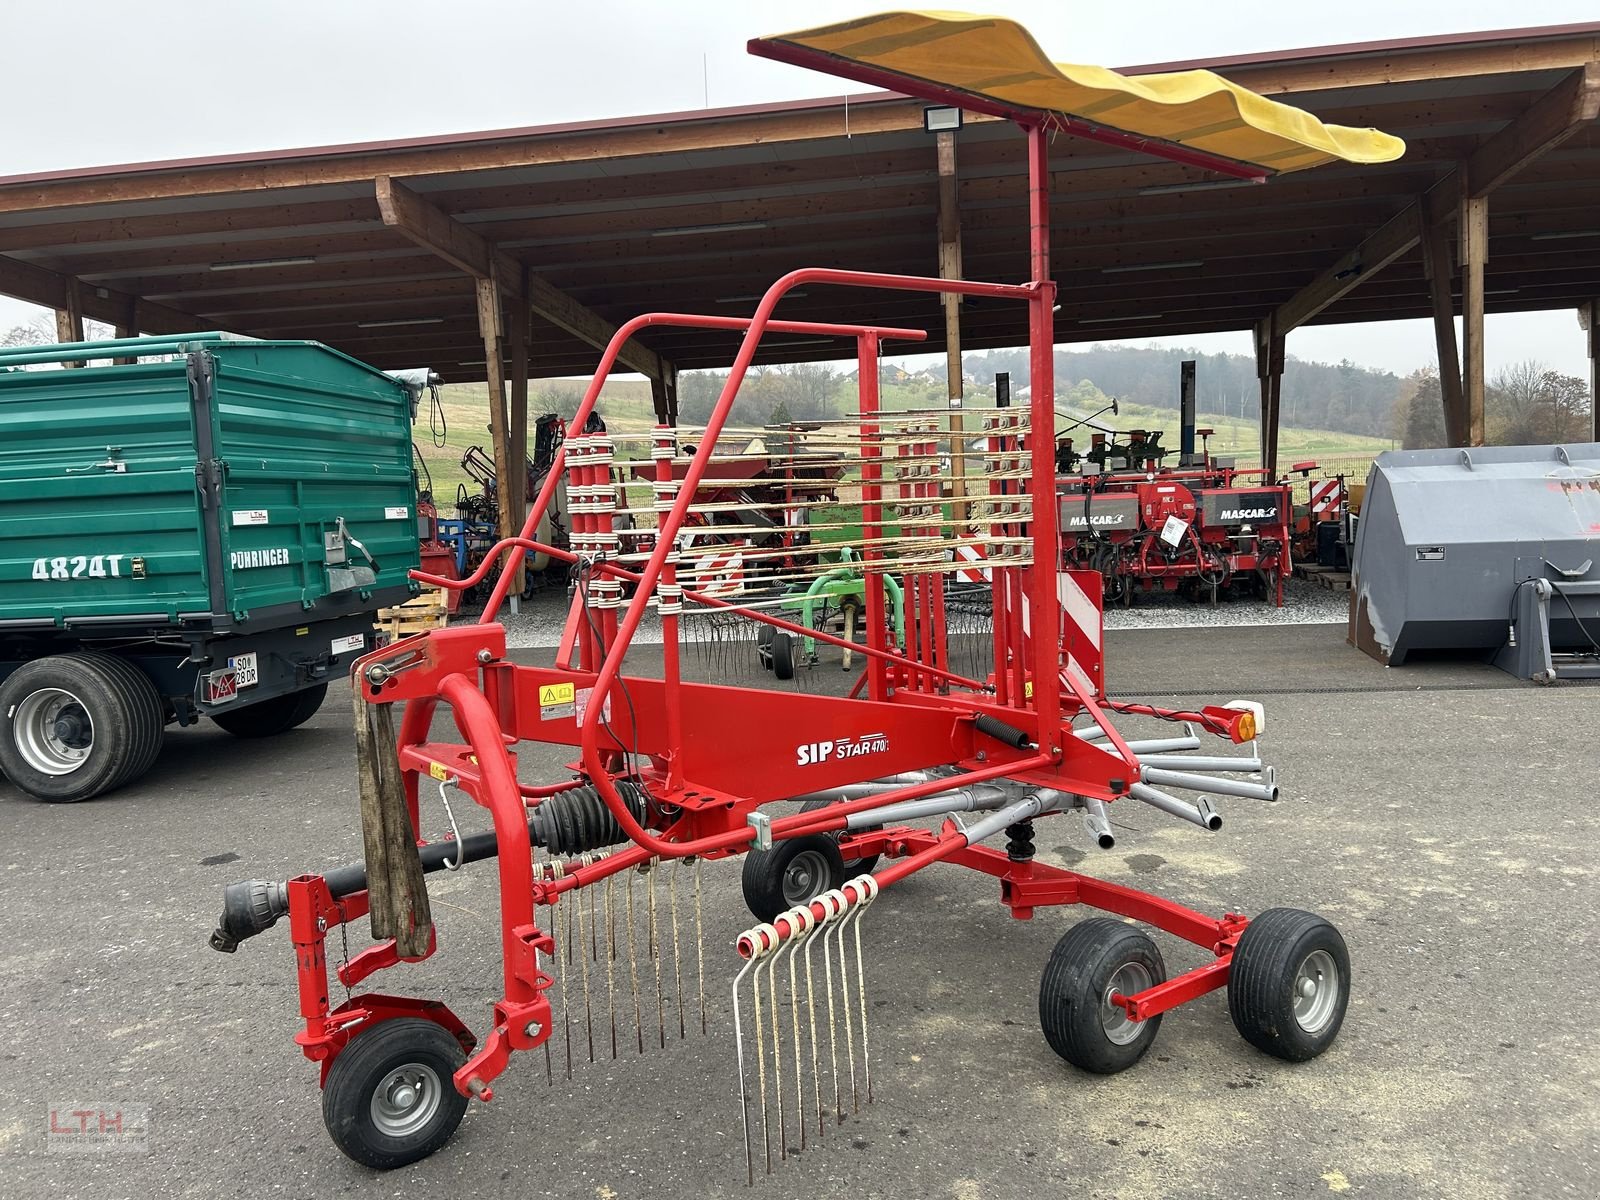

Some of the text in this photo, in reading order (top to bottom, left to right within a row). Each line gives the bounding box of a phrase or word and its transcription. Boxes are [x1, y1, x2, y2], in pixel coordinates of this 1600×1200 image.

[1220, 508, 1265, 520] MASCAR
[32, 554, 124, 581] 4824T
[237, 657, 247, 671] SO
[246, 668, 256, 682] DR
[796, 741, 834, 766] SIP
[836, 742, 871, 759] STAR
